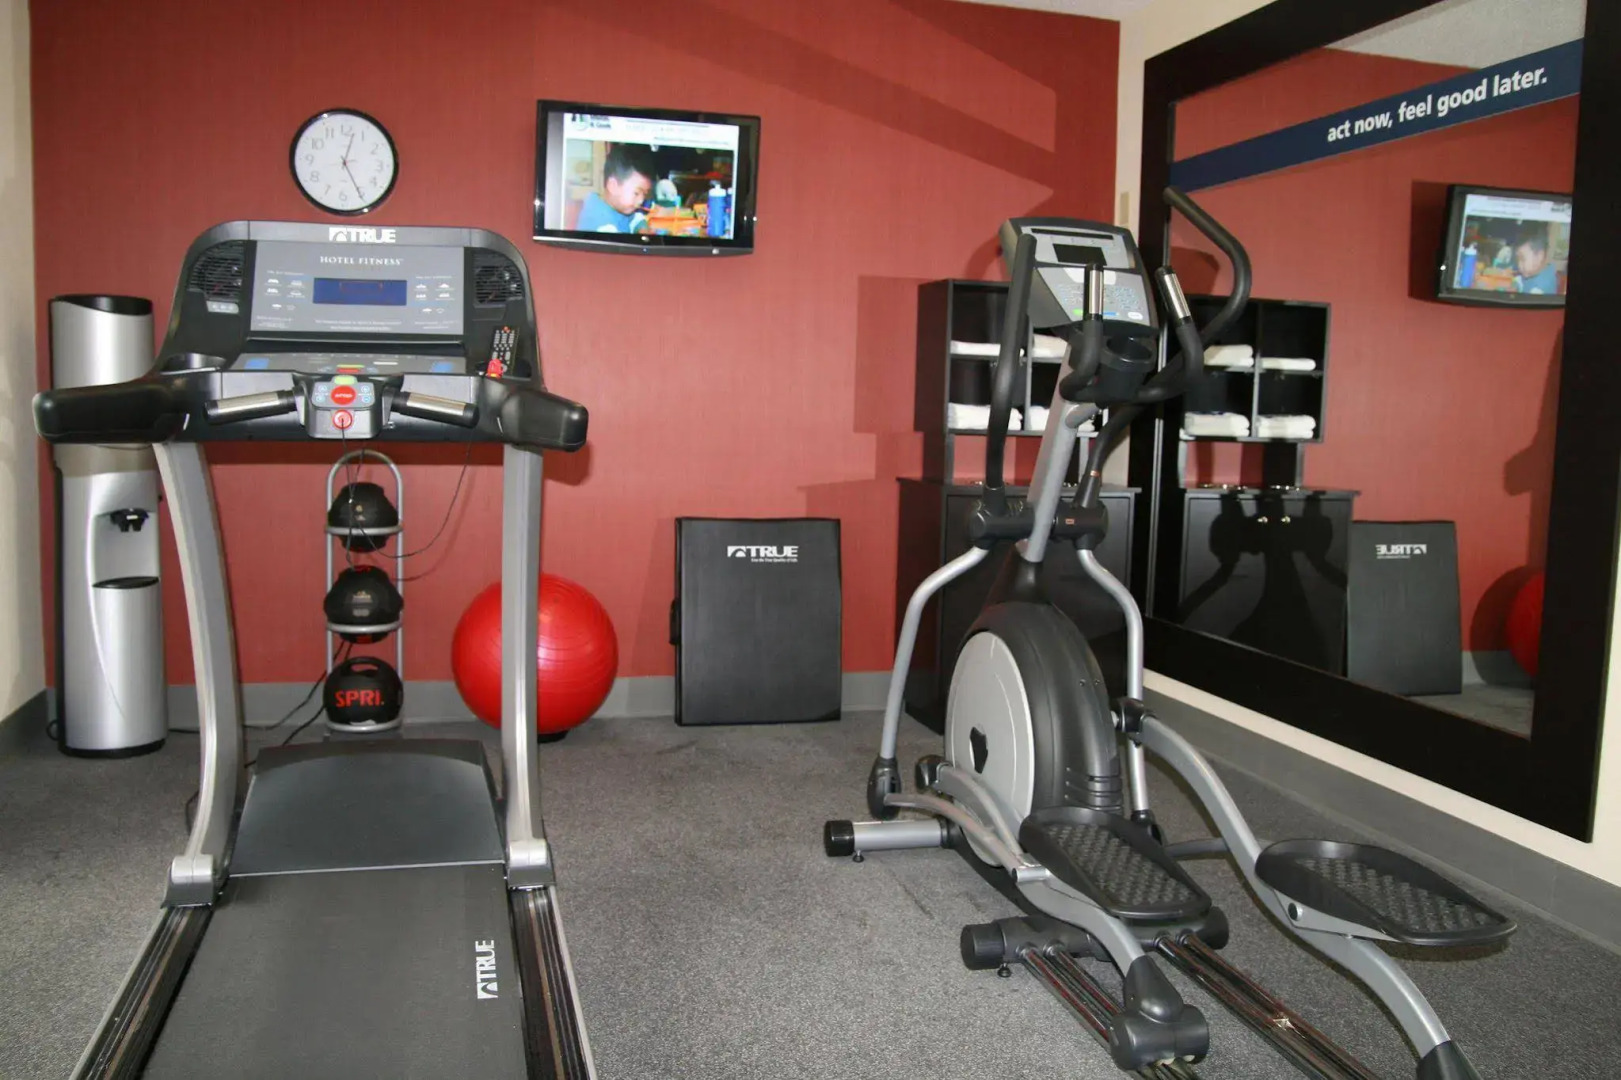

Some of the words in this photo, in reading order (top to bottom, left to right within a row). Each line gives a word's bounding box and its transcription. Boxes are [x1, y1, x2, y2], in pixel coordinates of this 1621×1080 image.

[1327, 121, 1351, 142] act
[1354, 112, 1393, 136] now,
[1398, 93, 1432, 123] feel
[1437, 78, 1487, 117] good
[1492, 66, 1548, 97] later.
[340, 124, 353, 137] 12
[311, 138, 325, 150] 10
[370, 143, 379, 155] 2
[305, 154, 315, 166] 9
[375, 160, 384, 172] 3
[310, 170, 320, 182] 8
[369, 176, 378, 188] 4
[324, 184, 332, 195] 7
[338, 191, 348, 202] 6
[347, 228, 396, 243] TRUE
[320, 256, 354, 265] HOTEL
[746, 545, 799, 558] TRUE
[475, 940, 497, 983] TRUE
